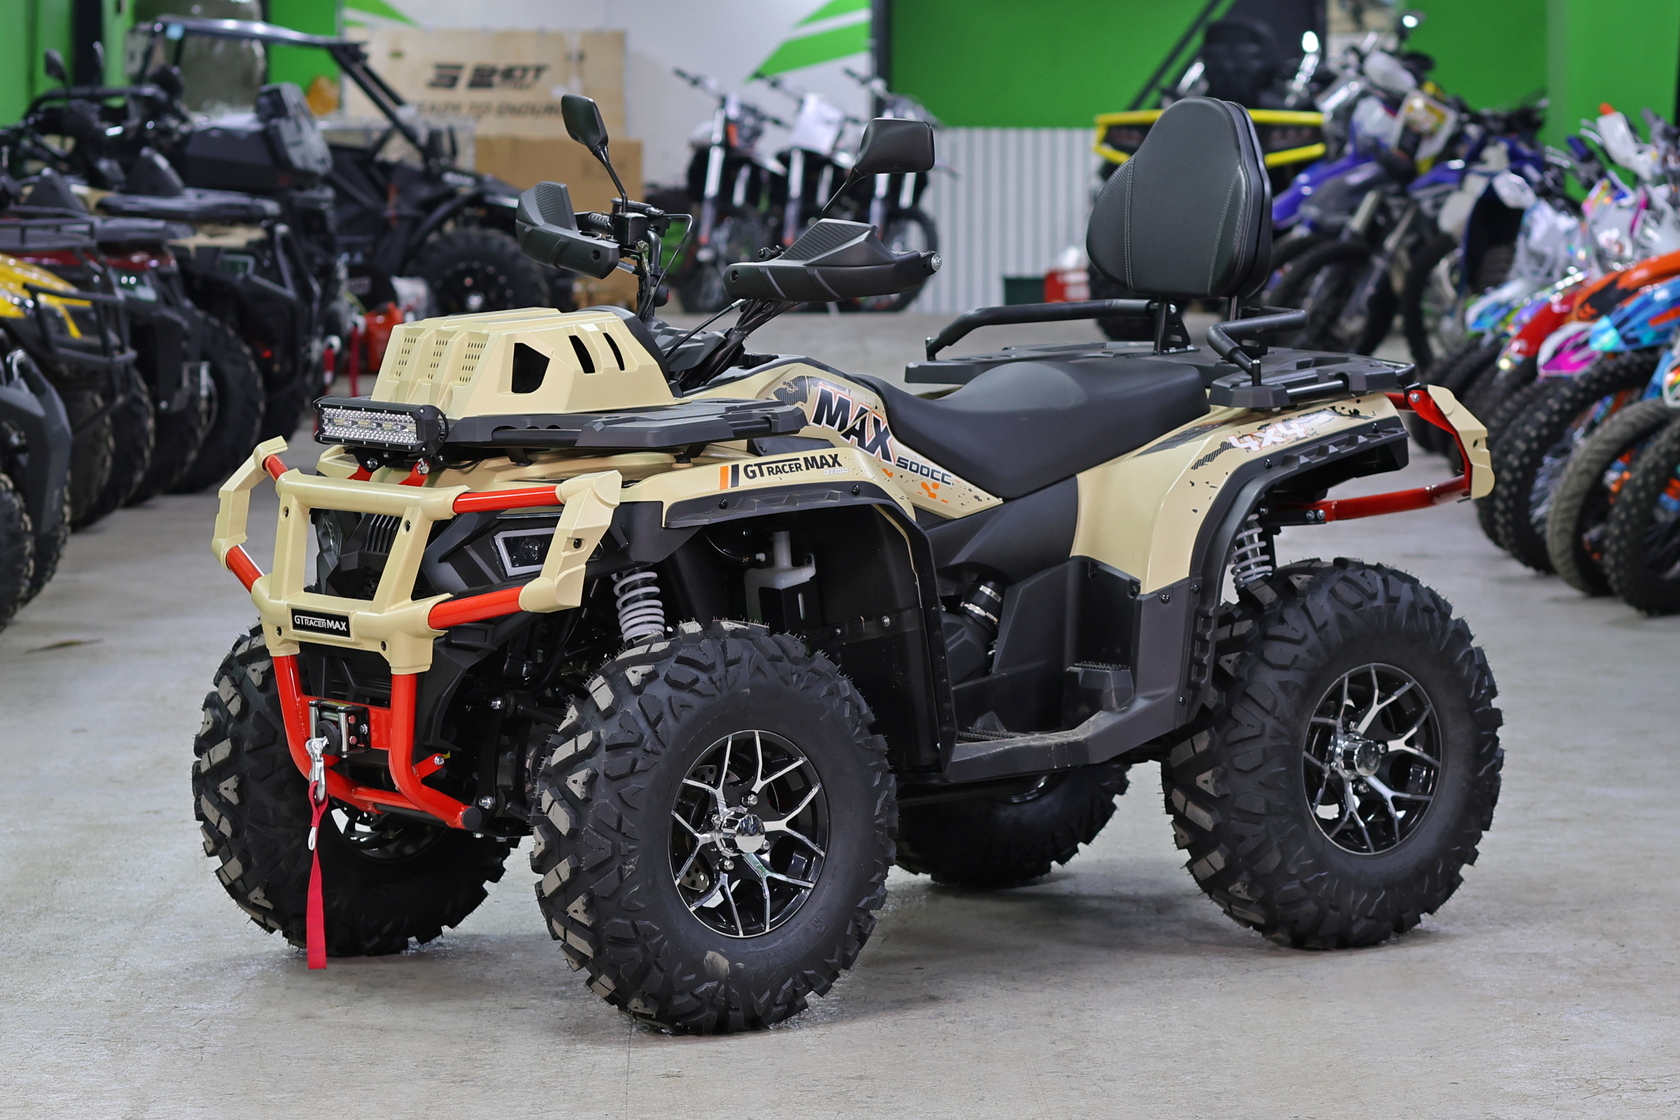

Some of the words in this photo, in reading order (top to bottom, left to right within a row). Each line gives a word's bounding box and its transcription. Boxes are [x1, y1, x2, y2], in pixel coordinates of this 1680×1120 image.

[809, 384, 897, 466] MAX
[803, 453, 843, 471] MAX
[327, 620, 347, 632] MAX
